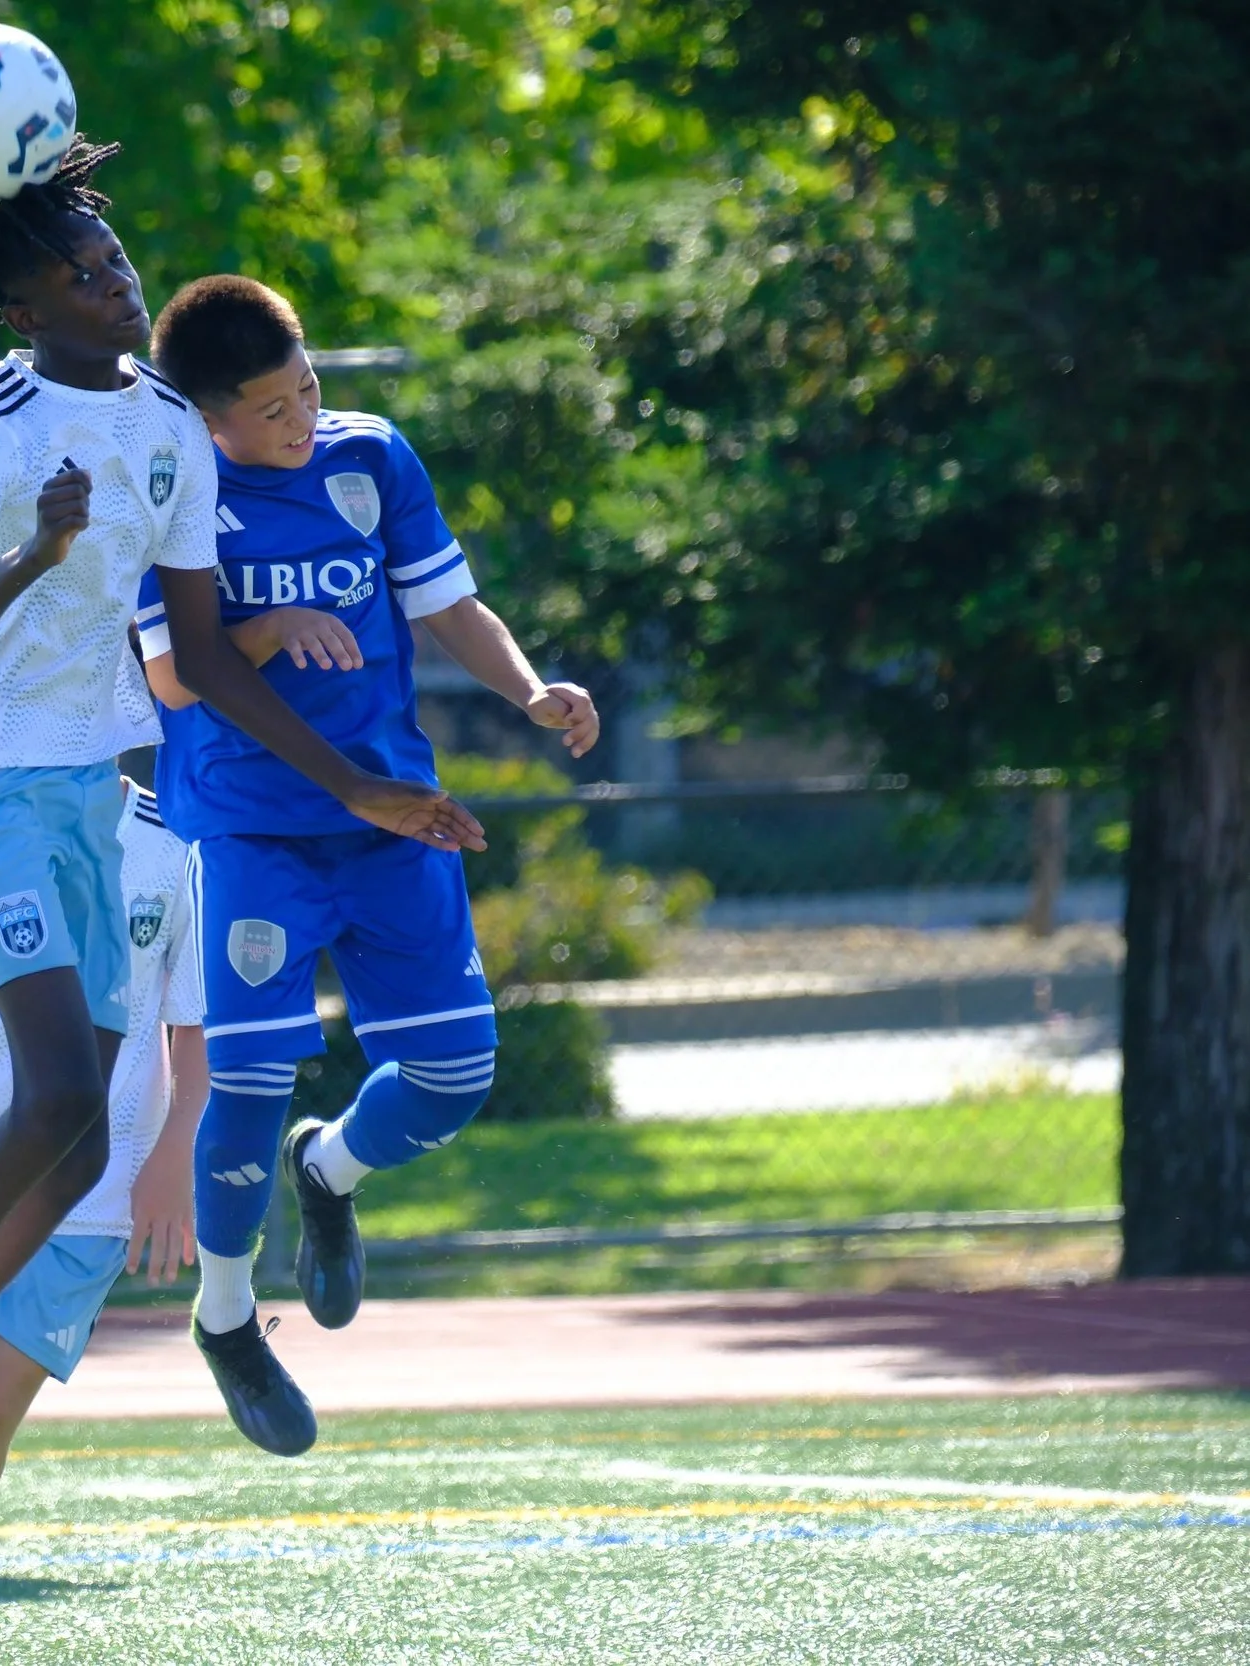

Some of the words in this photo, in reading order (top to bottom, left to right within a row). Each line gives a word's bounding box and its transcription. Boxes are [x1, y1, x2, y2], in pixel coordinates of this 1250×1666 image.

[153, 461, 173, 472] AFC
[133, 903, 163, 915] AFC
[2, 907, 36, 925] AFC
